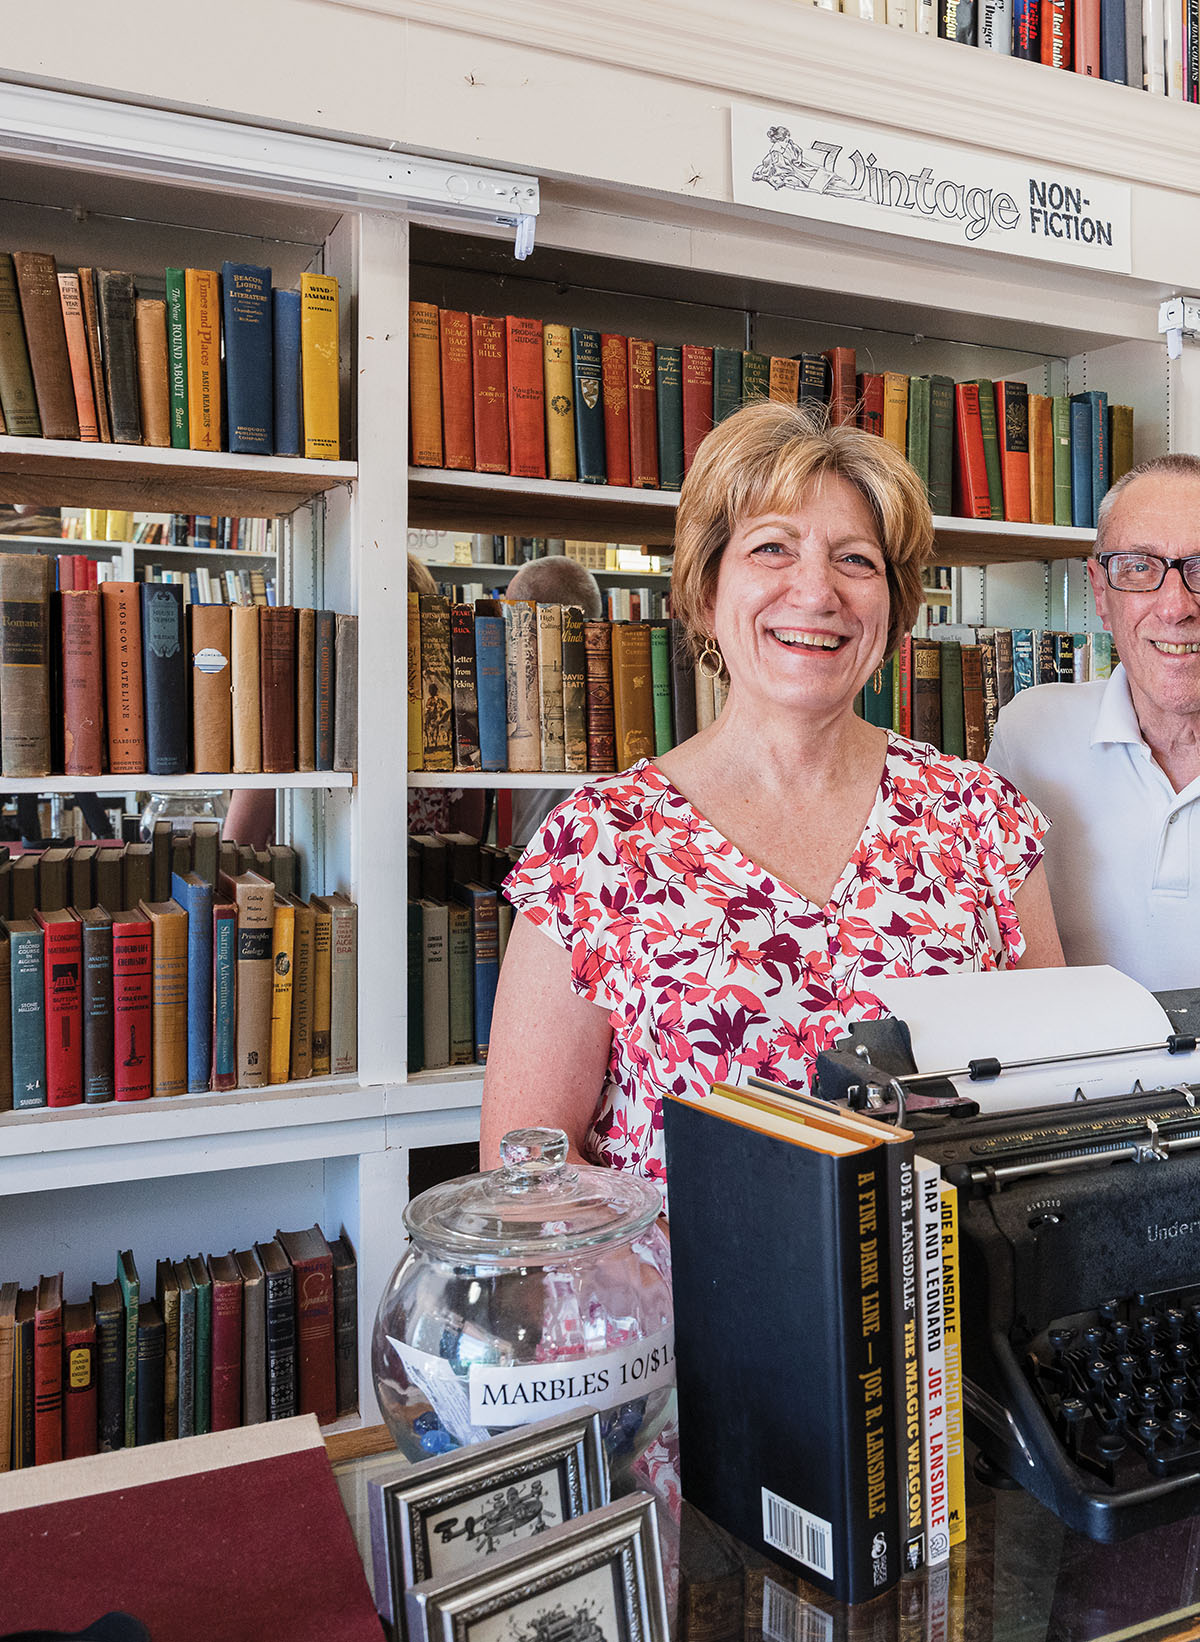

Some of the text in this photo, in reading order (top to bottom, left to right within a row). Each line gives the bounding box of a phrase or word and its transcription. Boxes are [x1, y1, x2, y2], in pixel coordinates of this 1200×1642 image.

[985, 3, 996, 47] Danger
[1053, 12, 1064, 35] Red
[1191, 21, 1199, 45] JOAN
[1191, 46, 1200, 81] COLLINS
[810, 139, 1021, 241] Vintage
[1029, 178, 1090, 207] NON-
[1029, 208, 1112, 247] FICTION
[233, 275, 263, 285] BEACON
[236, 281, 262, 291] LIGHTS
[229, 291, 268, 301] LITERATURE
[304, 293, 335, 302] JAMMER
[172, 288, 183, 359] The New ROUND
[476, 329, 501, 338] HEART
[448, 337, 467, 346] BAG
[483, 343, 496, 351] THE
[579, 340, 599, 349] TIDES
[583, 333, 594, 341] THE
[478, 350, 502, 358] HILLS
[197, 309, 212, 446] and Places BASIC 4
[539, 615, 555, 623] High
[119, 602, 130, 719] MOSCOW DATELINE
[453, 656, 473, 664] Letter
[455, 668, 471, 676] from
[320, 646, 329, 732] COMMUNITY HEALTH
[453, 680, 475, 690] Peking
[985, 677, 996, 716] Smiling
[240, 932, 270, 941] Principles
[245, 940, 252, 948] of
[241, 946, 265, 956] Geology
[336, 946, 353, 954] BRA
[218, 925, 230, 1016] Sharing Adventures
[298, 943, 309, 1043] FRIENDLY VILLAGE
[857, 1171, 875, 1187] A
[858, 1189, 877, 1236] FINE
[859, 1240, 879, 1288] DARK
[861, 1291, 881, 1340] LINE
[126, 1296, 138, 1375] MY WORD BOOK
[940, 1200, 961, 1458] JOE R. LANSDALE MUCHO MOJO
[900, 1161, 922, 1530] JOE R. LANSDALE THE MAGIC WAGON
[923, 1177, 945, 1529] HAP AND LEONARD JOE R. LANSDALE
[481, 1369, 609, 1406] MARBLES
[859, 1366, 883, 1406] JOE
[863, 1408, 883, 1429] R.
[864, 1434, 887, 1519] LANSDALE
